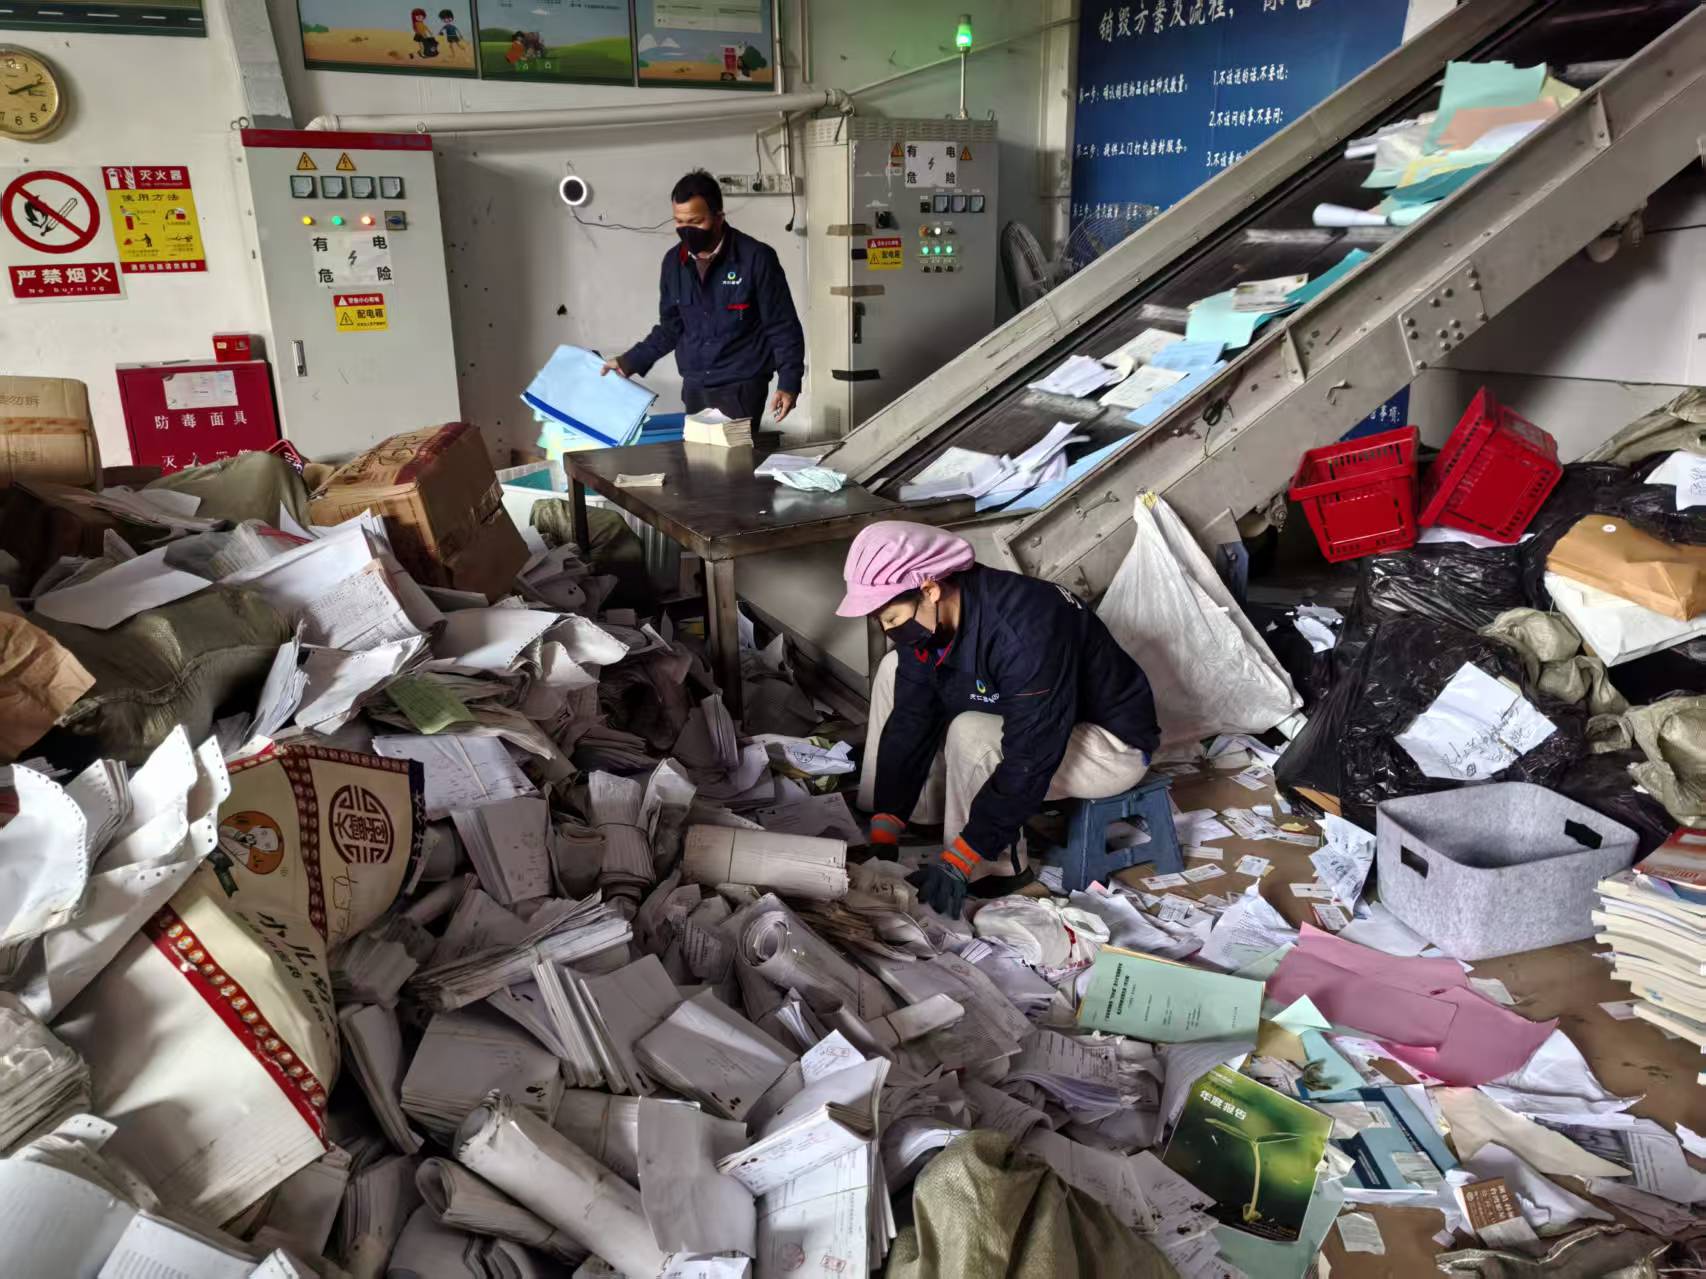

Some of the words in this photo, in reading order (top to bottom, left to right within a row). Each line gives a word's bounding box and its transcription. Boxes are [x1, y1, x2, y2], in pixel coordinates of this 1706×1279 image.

[15, 115, 23, 126] 6
[30, 112, 38, 122] 5
[906, 145, 918, 158] 有
[945, 146, 956, 158] 电
[139, 169, 182, 181] 灭火器
[906, 171, 918, 184] 危
[945, 172, 956, 184] 险
[121, 193, 181, 202] 使用方法
[312, 237, 328, 252] 有
[372, 235, 388, 250] 电
[16, 266, 112, 286] 严禁烟火
[318, 268, 334, 283] 危
[376, 265, 392, 281] 险
[357, 308, 384, 319] 配电箱
[154, 410, 248, 430] 防毒面具
[1199, 1090, 1247, 1121] 年度报告
